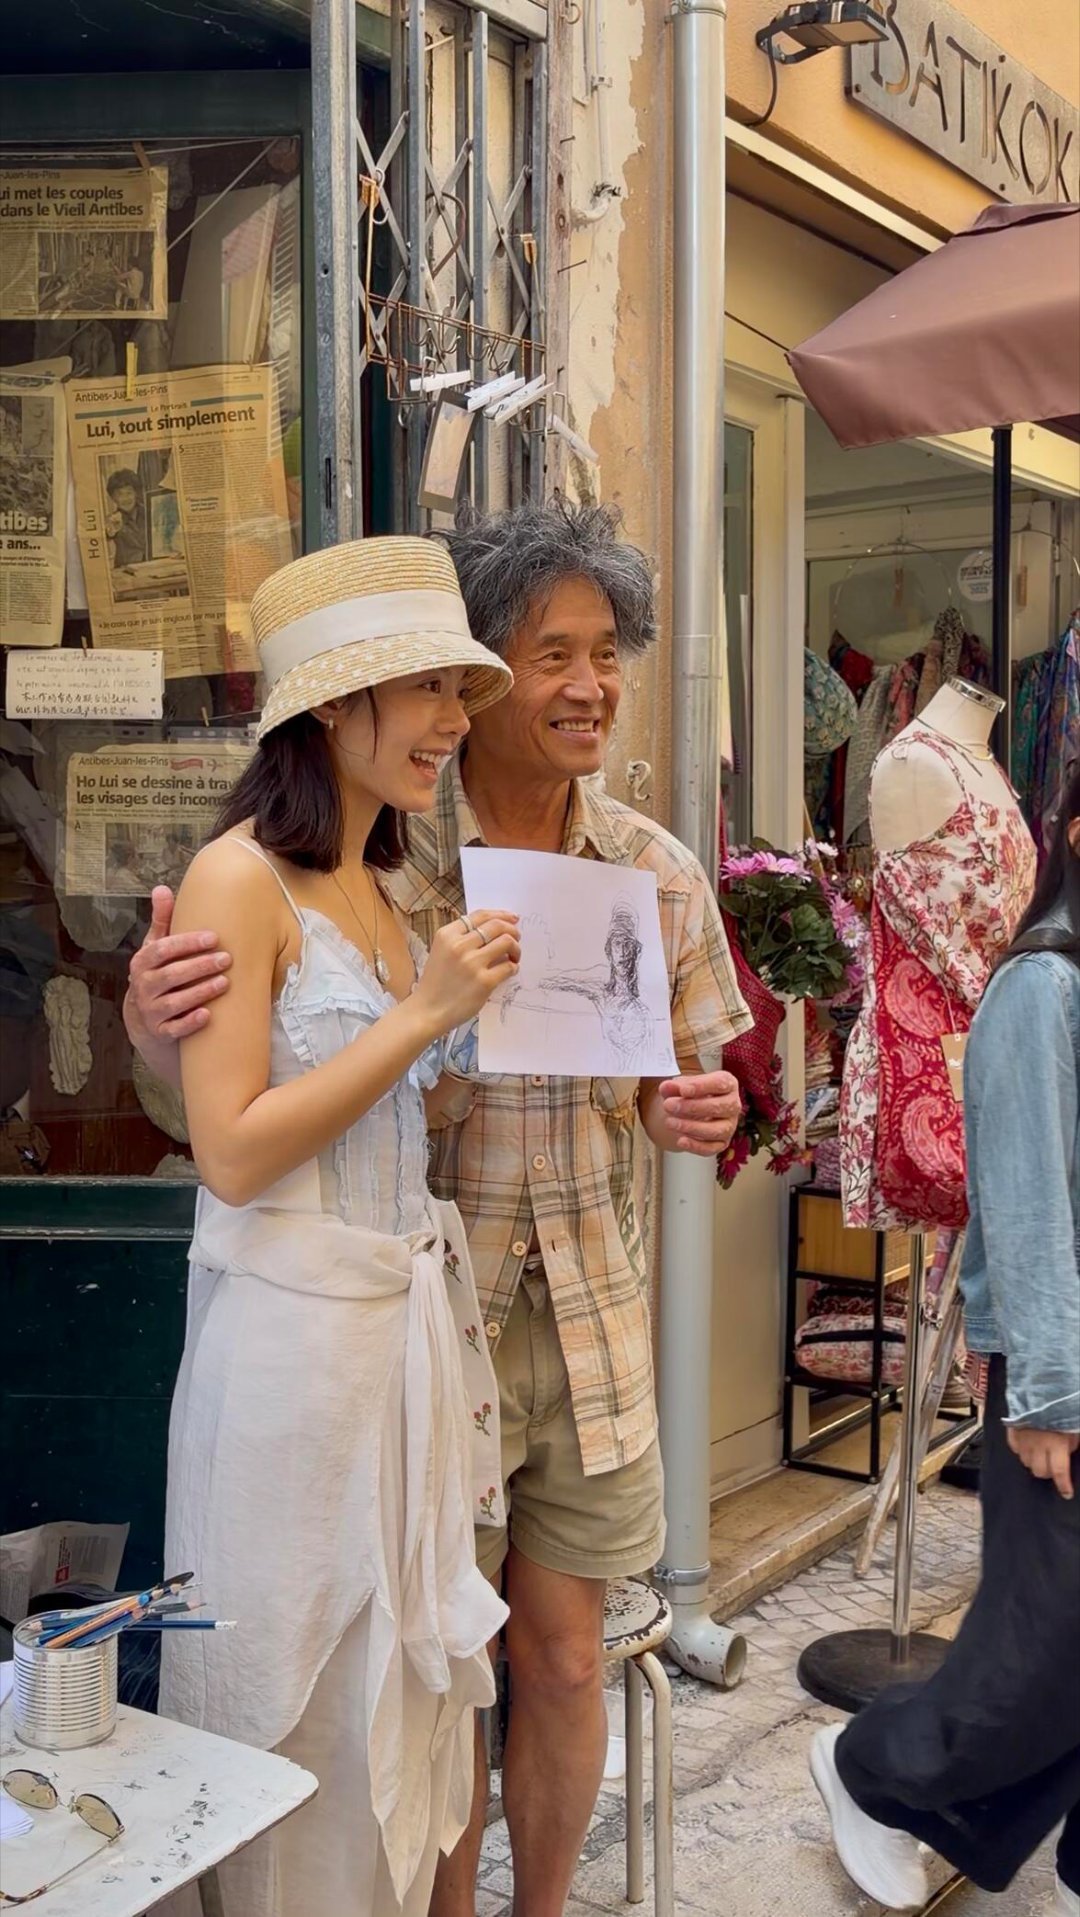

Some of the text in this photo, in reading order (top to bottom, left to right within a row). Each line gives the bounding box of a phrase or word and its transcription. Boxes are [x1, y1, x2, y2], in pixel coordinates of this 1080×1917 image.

[14, 187, 42, 200] met
[47, 186, 66, 200] les
[70, 186, 124, 201] couples
[0, 202, 144, 217] dans le Vieil Antibes
[87, 421, 116, 438] Lui,
[119, 417, 153, 435] tout
[157, 406, 256, 431] simplement
[83, 509, 100, 559] Ho Lui
[76, 775, 96, 788] Ho
[99, 774, 118, 788] Lui
[122, 777, 137, 788] se
[141, 775, 193, 789] dessine
[196, 776, 205, 790] à
[77, 790, 95, 804] les
[98, 790, 148, 808] visages
[152, 791, 176, 805] des
